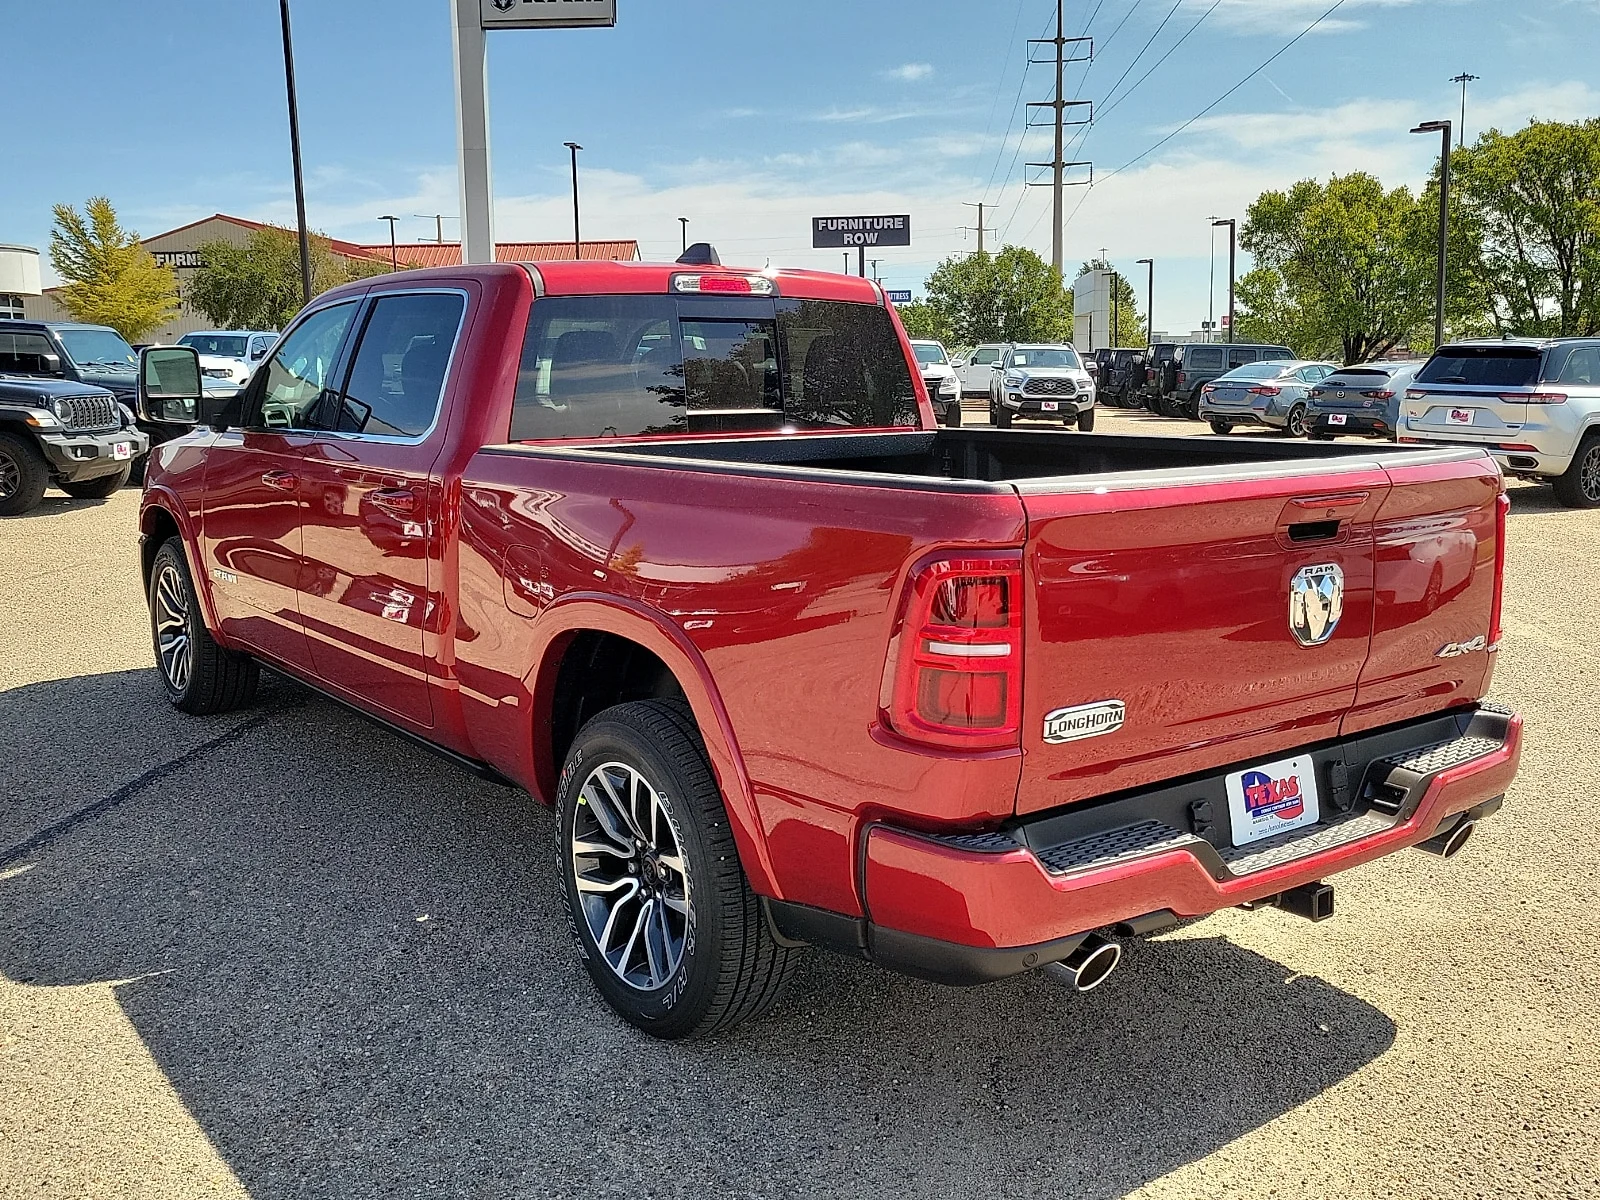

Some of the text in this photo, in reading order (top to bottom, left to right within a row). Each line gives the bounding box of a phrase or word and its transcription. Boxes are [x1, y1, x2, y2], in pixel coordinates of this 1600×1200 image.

[818, 217, 904, 231] FURNITURE
[843, 232, 879, 245] ROW
[1304, 565, 1335, 575] RAM
[1246, 775, 1299, 808] TEXAS
